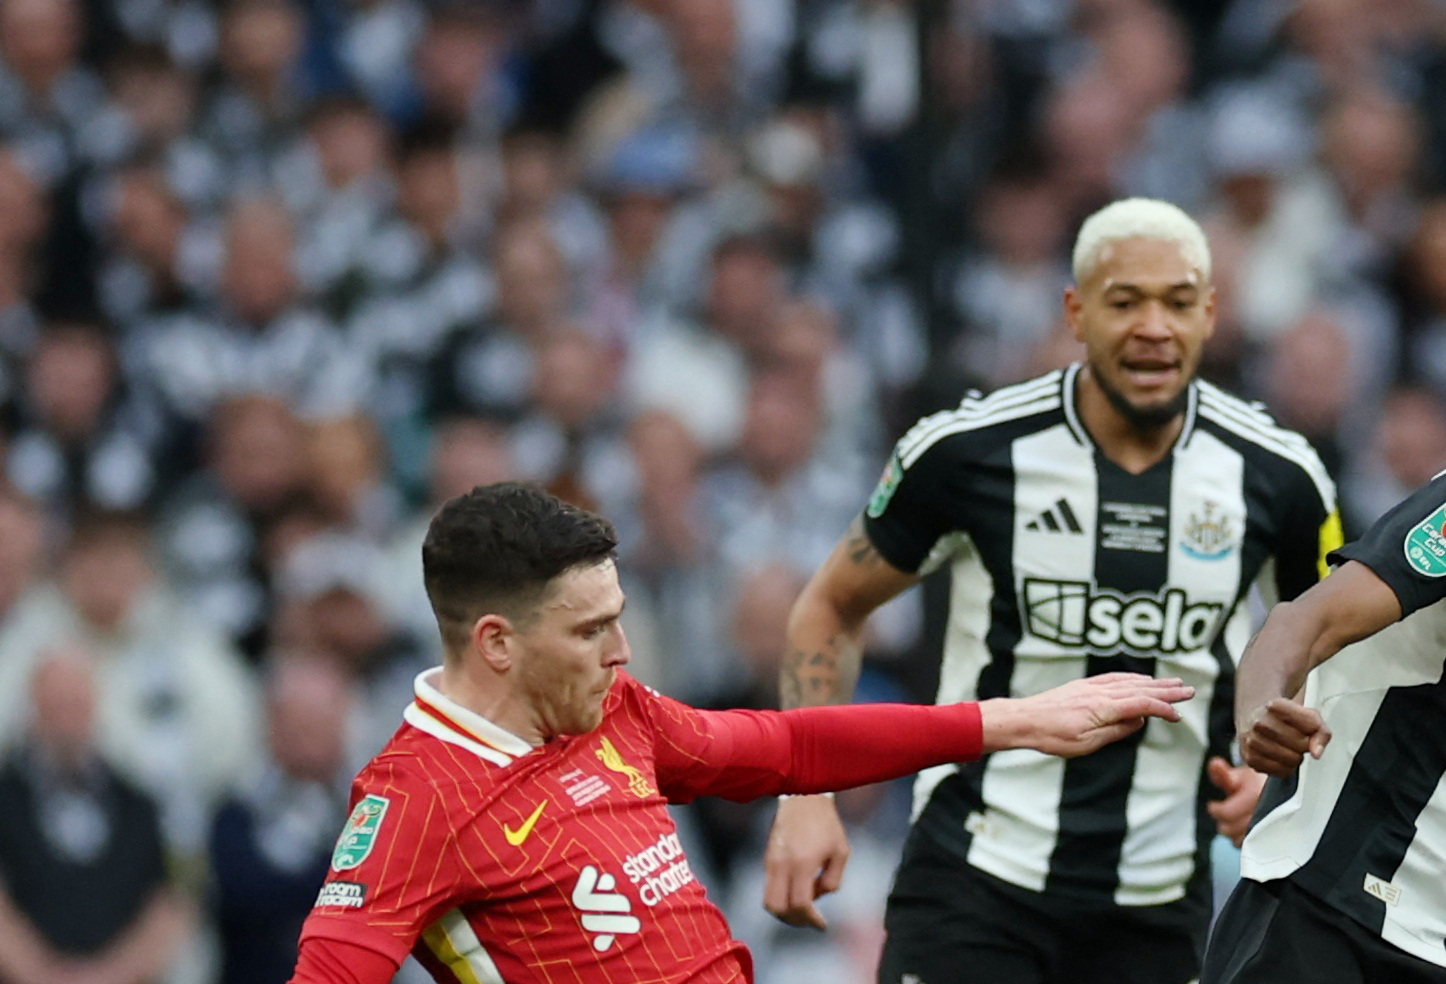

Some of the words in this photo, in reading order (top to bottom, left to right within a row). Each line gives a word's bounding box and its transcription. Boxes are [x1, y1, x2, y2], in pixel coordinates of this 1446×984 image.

[1424, 538, 1446, 557] Cup
[1086, 590, 1223, 651] sela
[622, 832, 684, 884] standa
